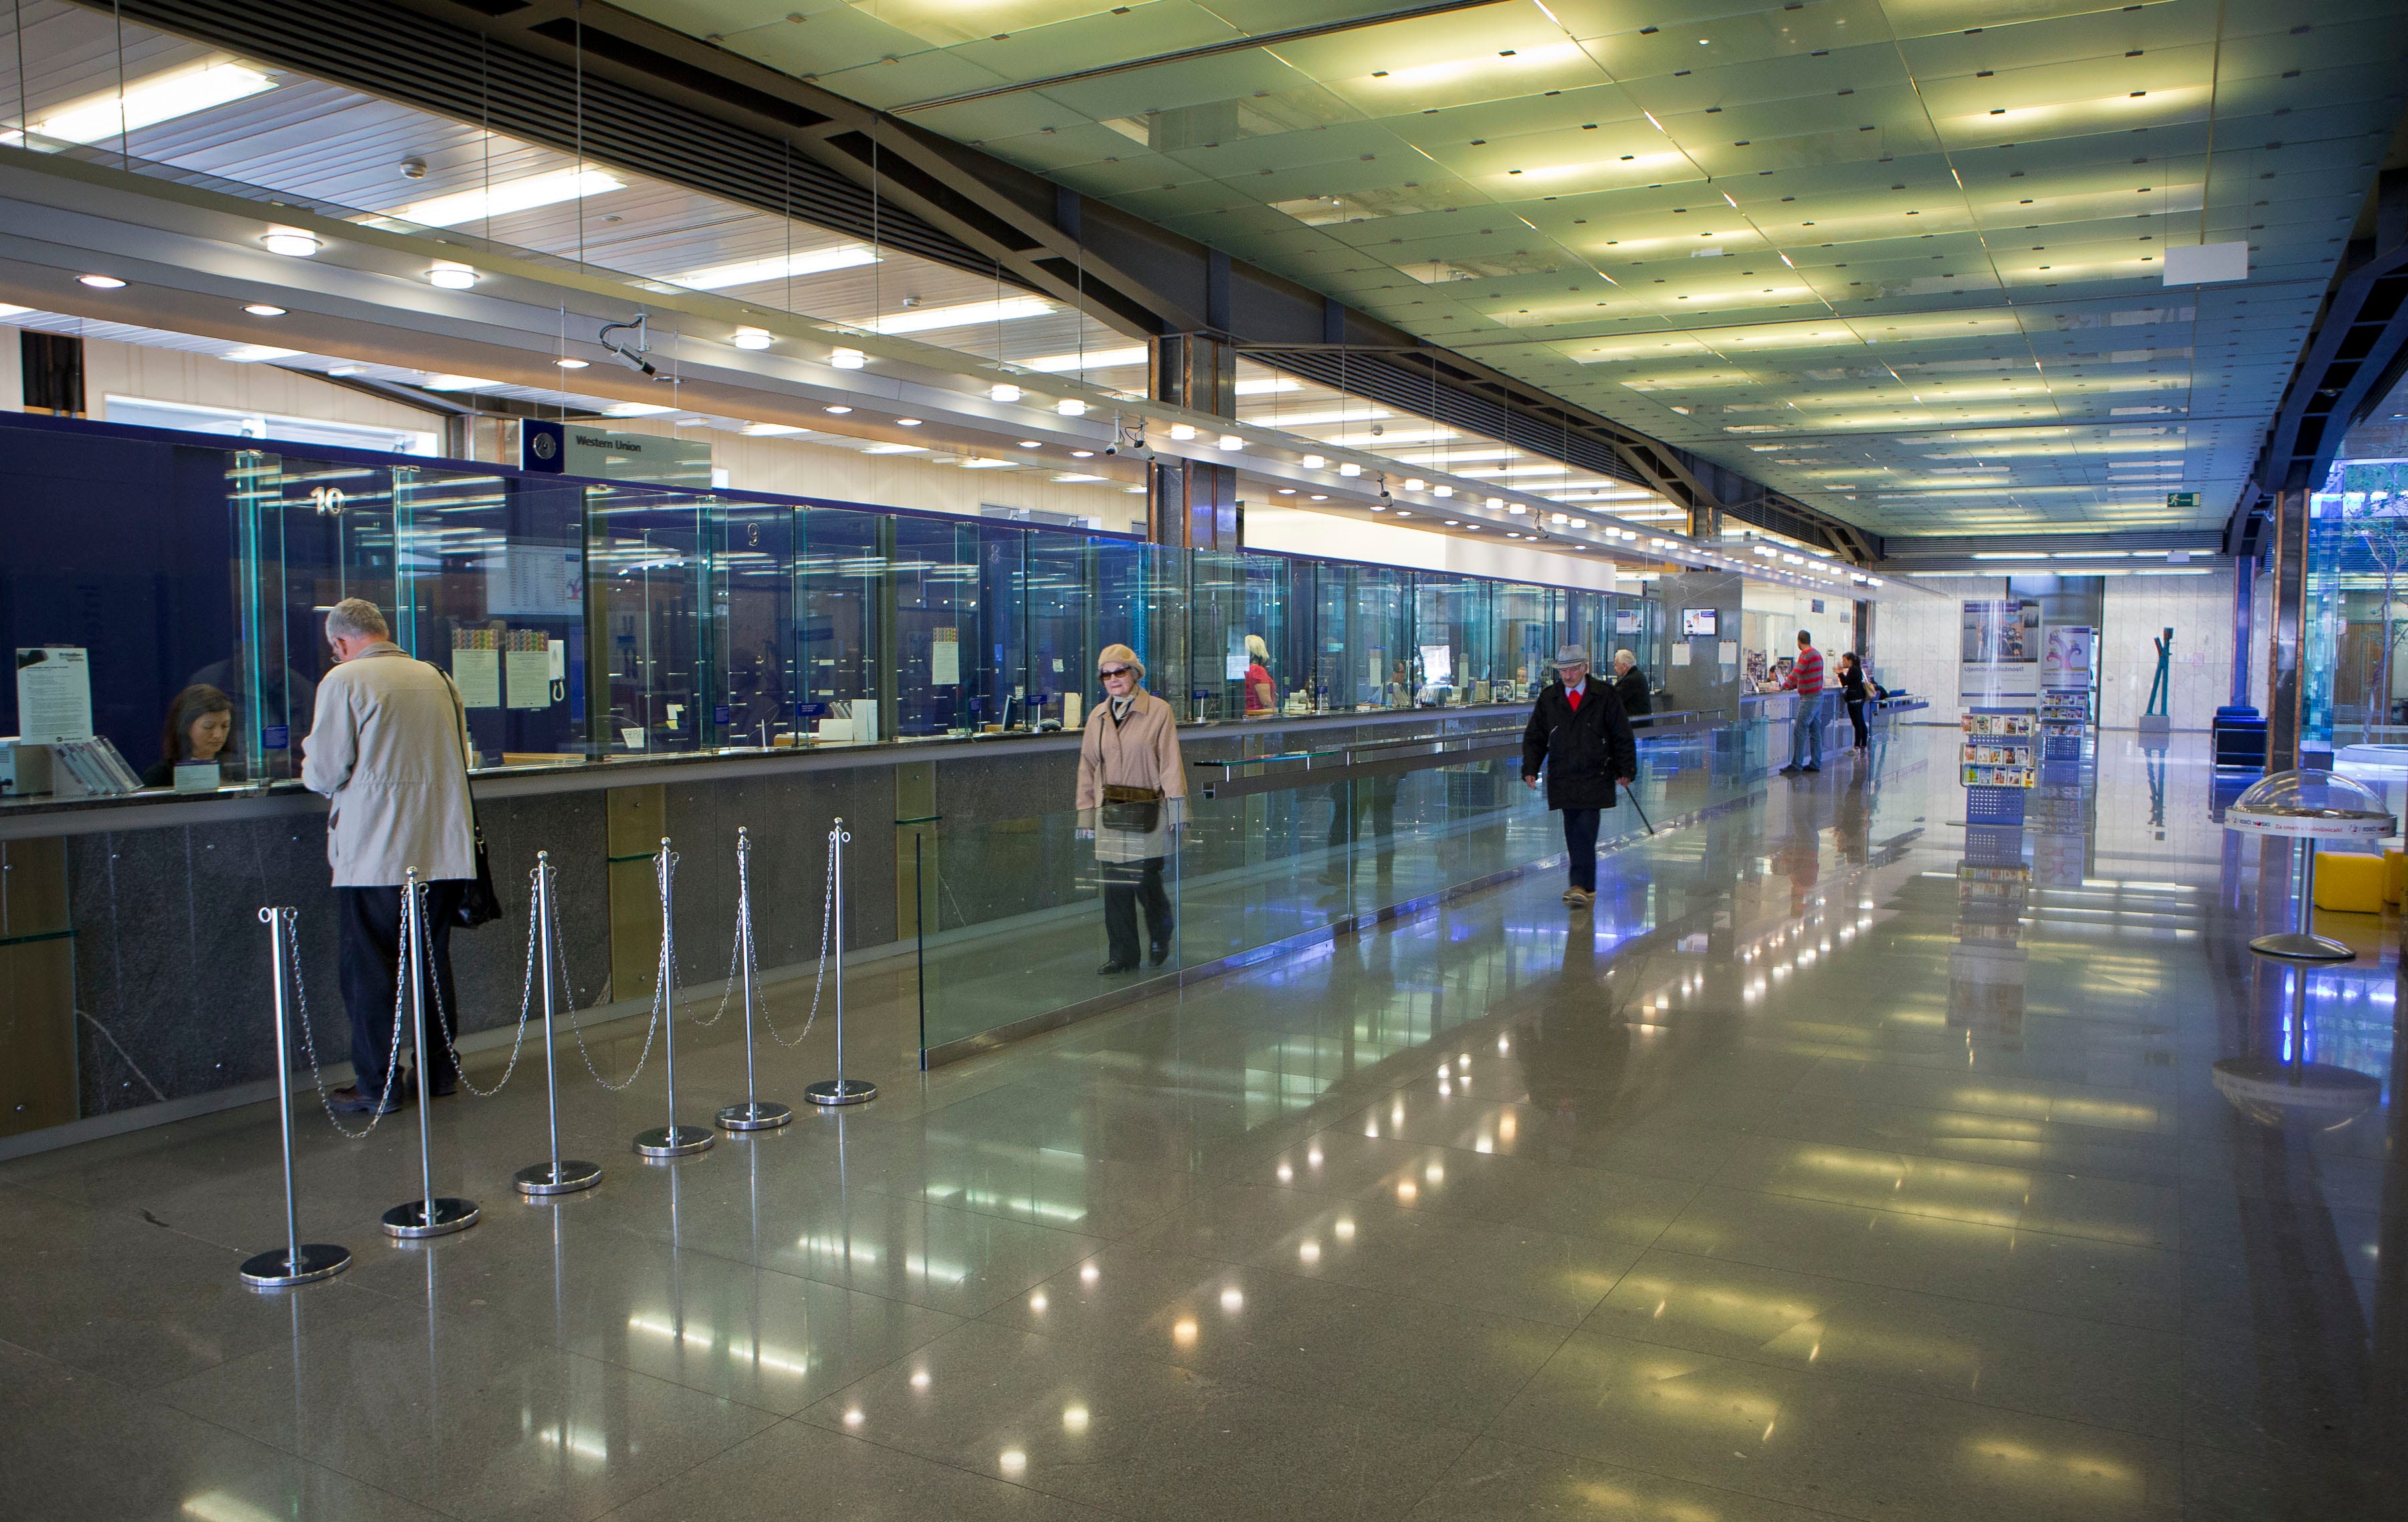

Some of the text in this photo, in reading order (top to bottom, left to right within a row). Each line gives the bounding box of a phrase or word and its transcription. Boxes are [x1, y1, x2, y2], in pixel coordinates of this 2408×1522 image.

[576, 434, 642, 452] Western Union
[310, 486, 346, 516] 10
[747, 522, 761, 547] 9
[991, 544, 1001, 564] 8
